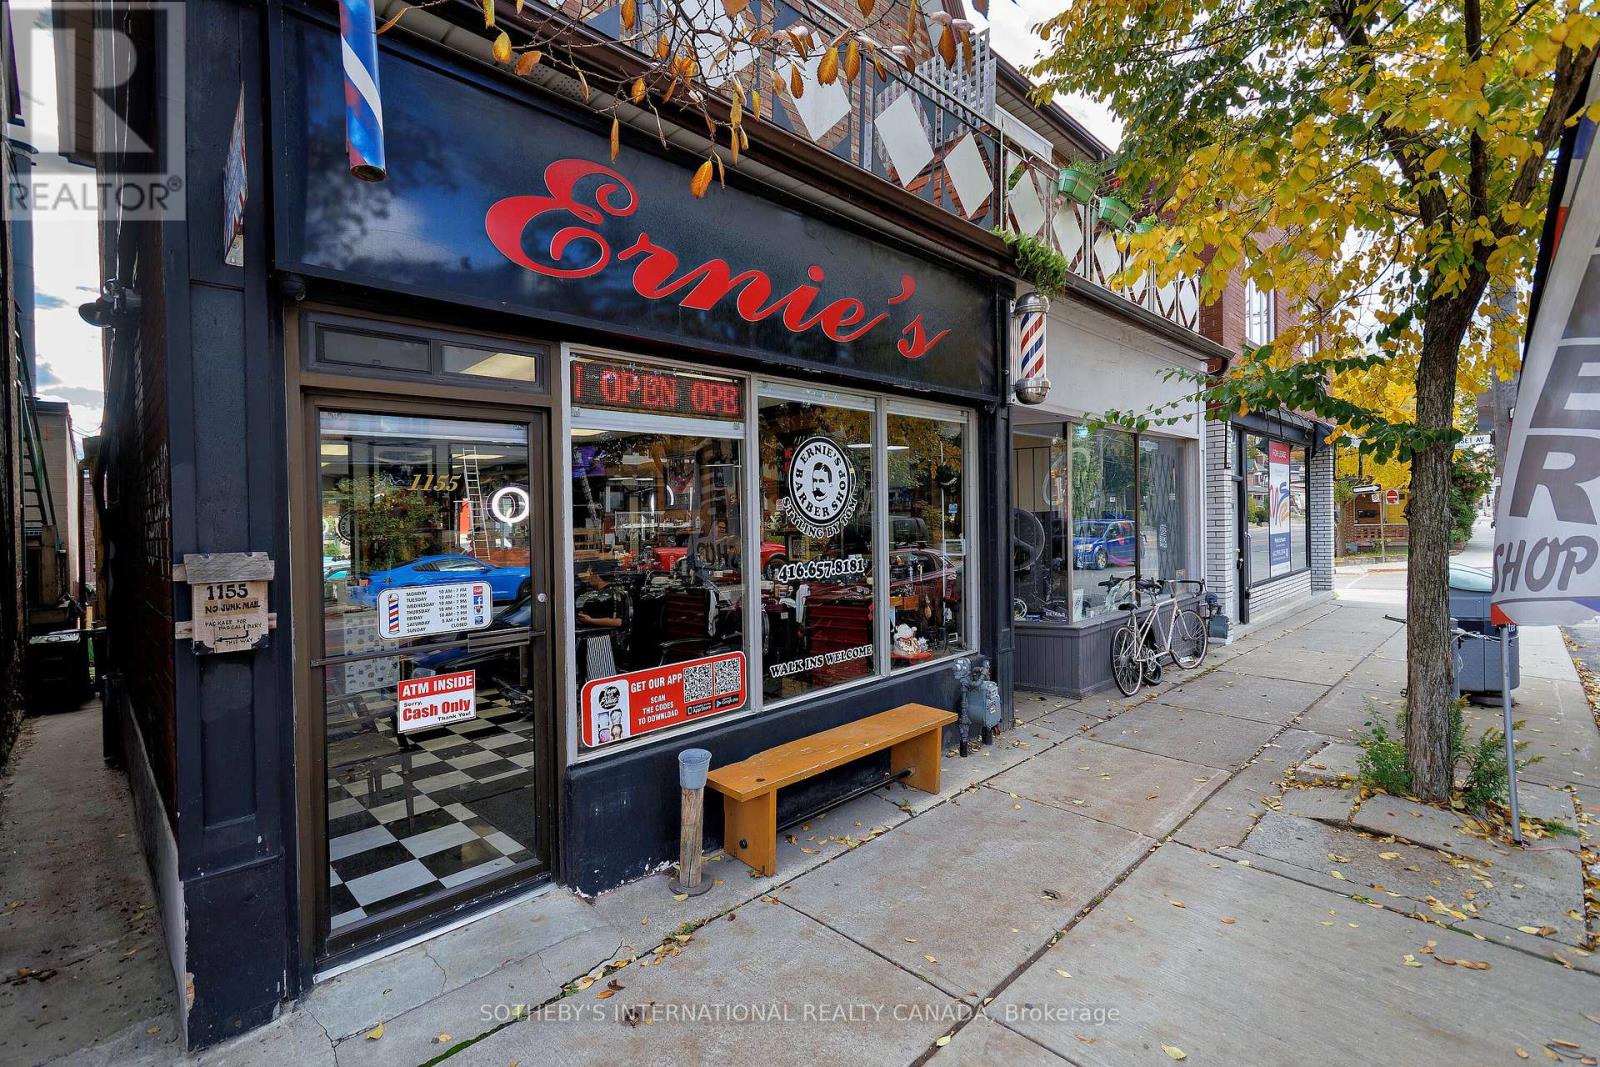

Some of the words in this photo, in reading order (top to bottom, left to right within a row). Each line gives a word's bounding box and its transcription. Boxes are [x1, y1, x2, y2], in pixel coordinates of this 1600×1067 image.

[485, 158, 951, 359] Ernie's
[599, 368, 677, 407] OPEN
[690, 381, 739, 413] OPE
[800, 444, 842, 466] ERNIE'S
[407, 474, 461, 491] 1155
[795, 468, 830, 517] BARBER
[831, 470, 846, 511] SHOP
[783, 496, 825, 539] STYLING
[826, 521, 841, 538] BY
[839, 497, 858, 526] TOM
[777, 558, 865, 583] 416.657.8181
[1494, 535, 1599, 595] SHOP
[206, 583, 248, 600] 1155
[205, 605, 218, 614] NO
[220, 603, 241, 612] JUNK
[242, 601, 261, 610] MAIL
[769, 660, 804, 679] WALK
[804, 654, 825, 670] INS
[825, 644, 873, 666] WELCOME
[402, 681, 429, 697] ATM
[433, 675, 473, 692] INSIDE
[631, 681, 646, 693] GET
[649, 676, 665, 689] OUR
[667, 673, 683, 685] APP
[402, 703, 438, 721] Cash
[441, 698, 471, 714] Only
[642, 706, 654, 715] THE
[655, 701, 674, 712] CODES
[650, 694, 666, 704] SCAN
[438, 714, 457, 722] Thank
[638, 717, 646, 725] TO
[647, 710, 679, 724] DOWNLOAD
